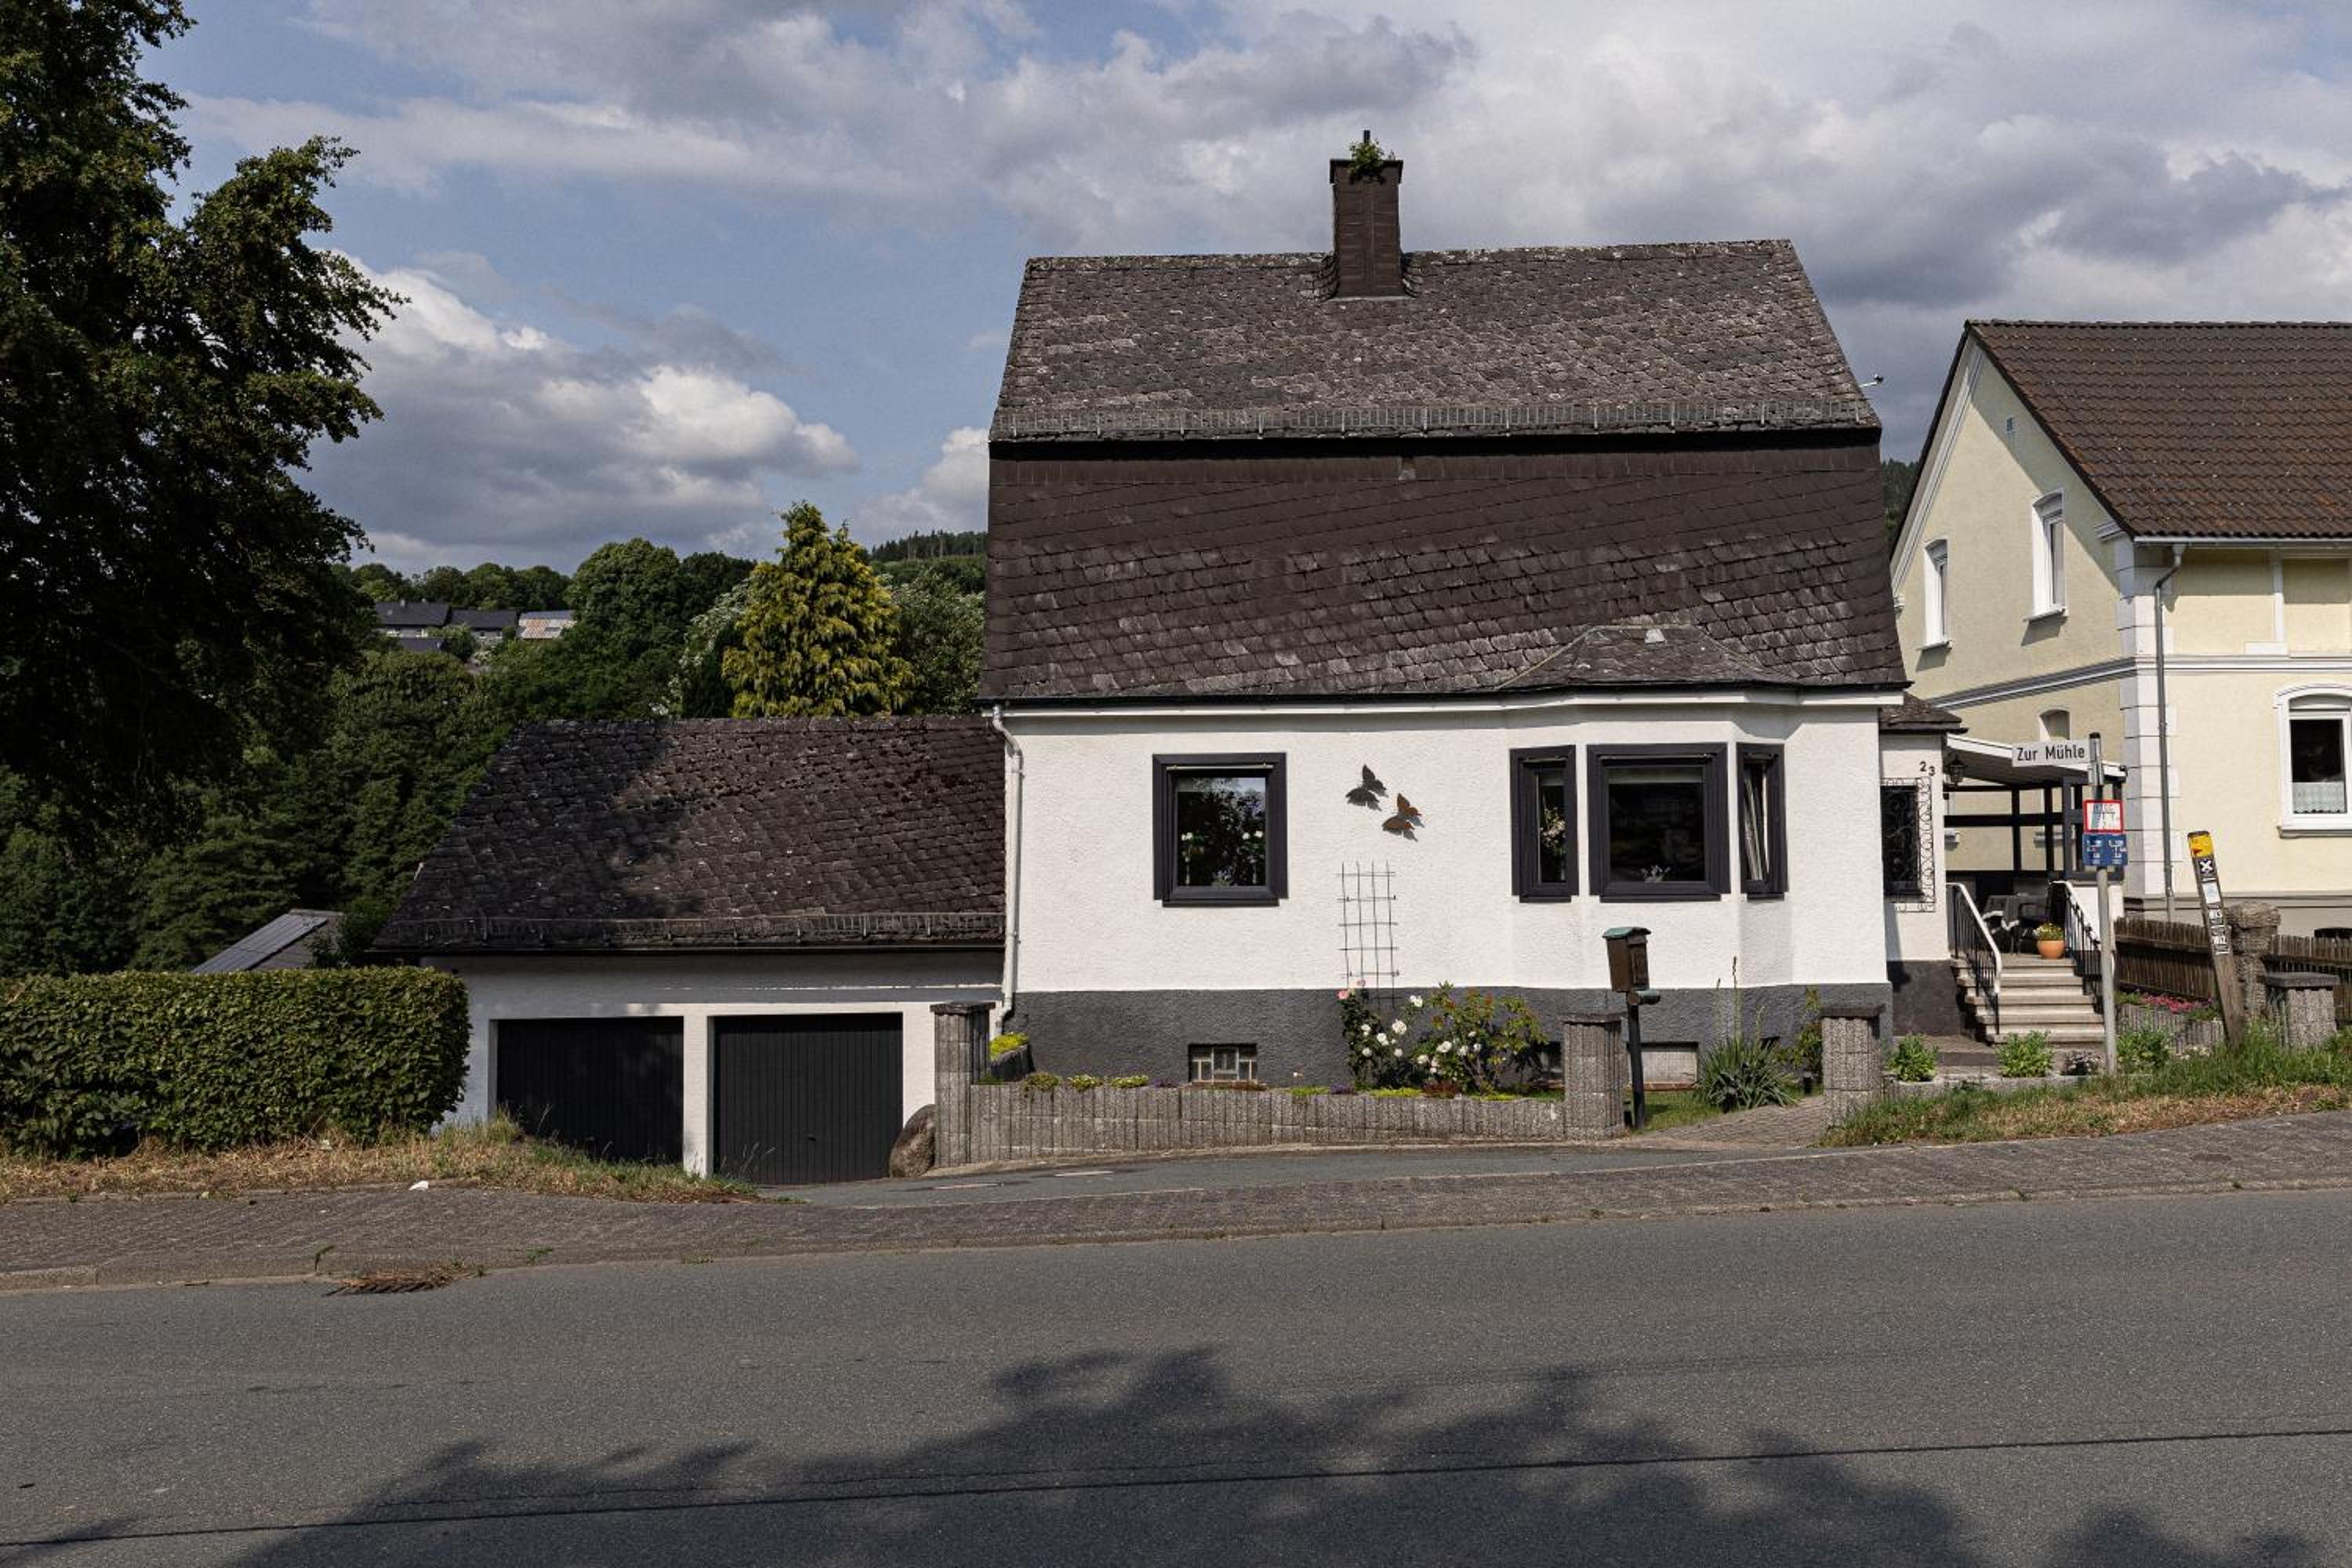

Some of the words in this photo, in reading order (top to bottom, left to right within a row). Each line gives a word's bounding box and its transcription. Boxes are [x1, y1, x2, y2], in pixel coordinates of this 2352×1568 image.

[2016, 747, 2038, 761] Zur
[2045, 744, 2085, 760] Mühle
[1919, 760, 1935, 776] 23
